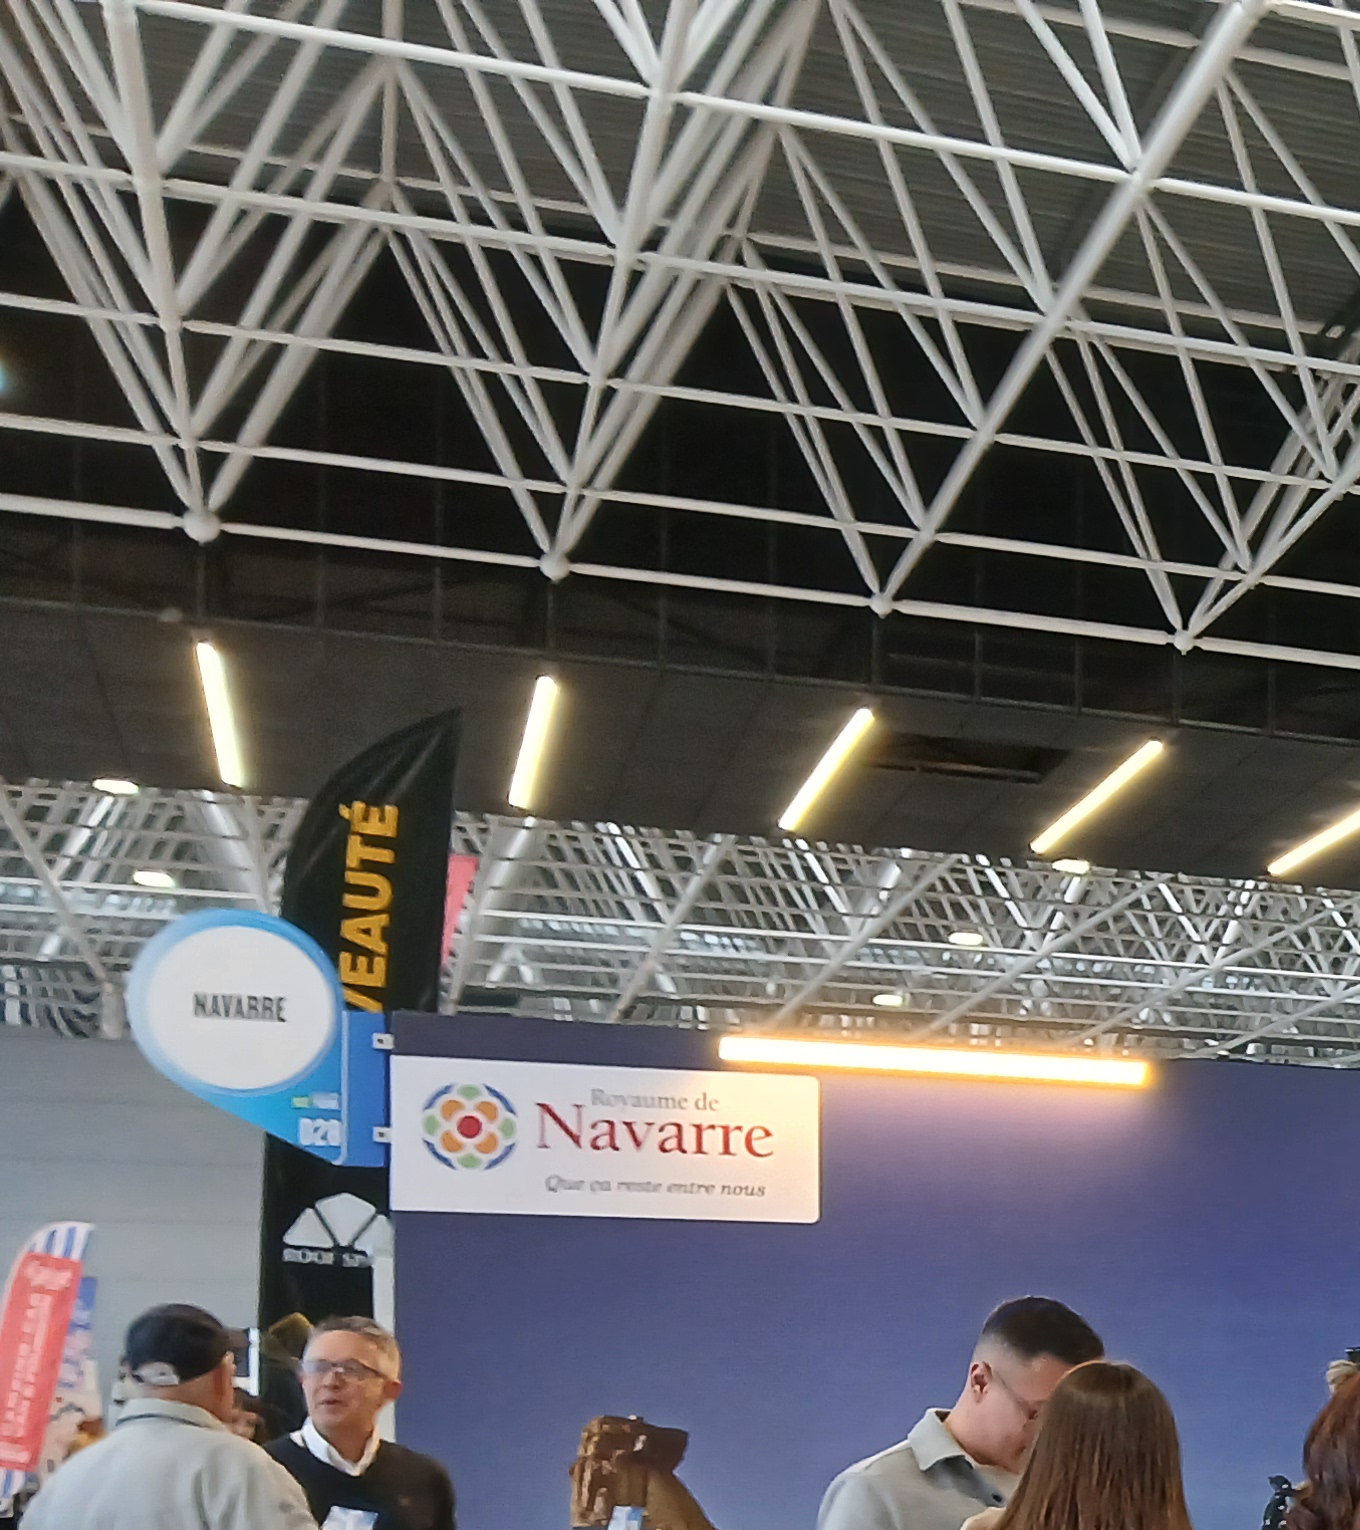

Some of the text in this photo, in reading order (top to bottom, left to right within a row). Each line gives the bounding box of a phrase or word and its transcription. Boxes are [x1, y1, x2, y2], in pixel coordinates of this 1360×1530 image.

[193, 991, 288, 1023] NAVARRE
[590, 1087, 720, 1112] Royaume de
[535, 1101, 775, 1158] Navarre
[666, 1180, 717, 1197] entre
[719, 1182, 767, 1199] nous
